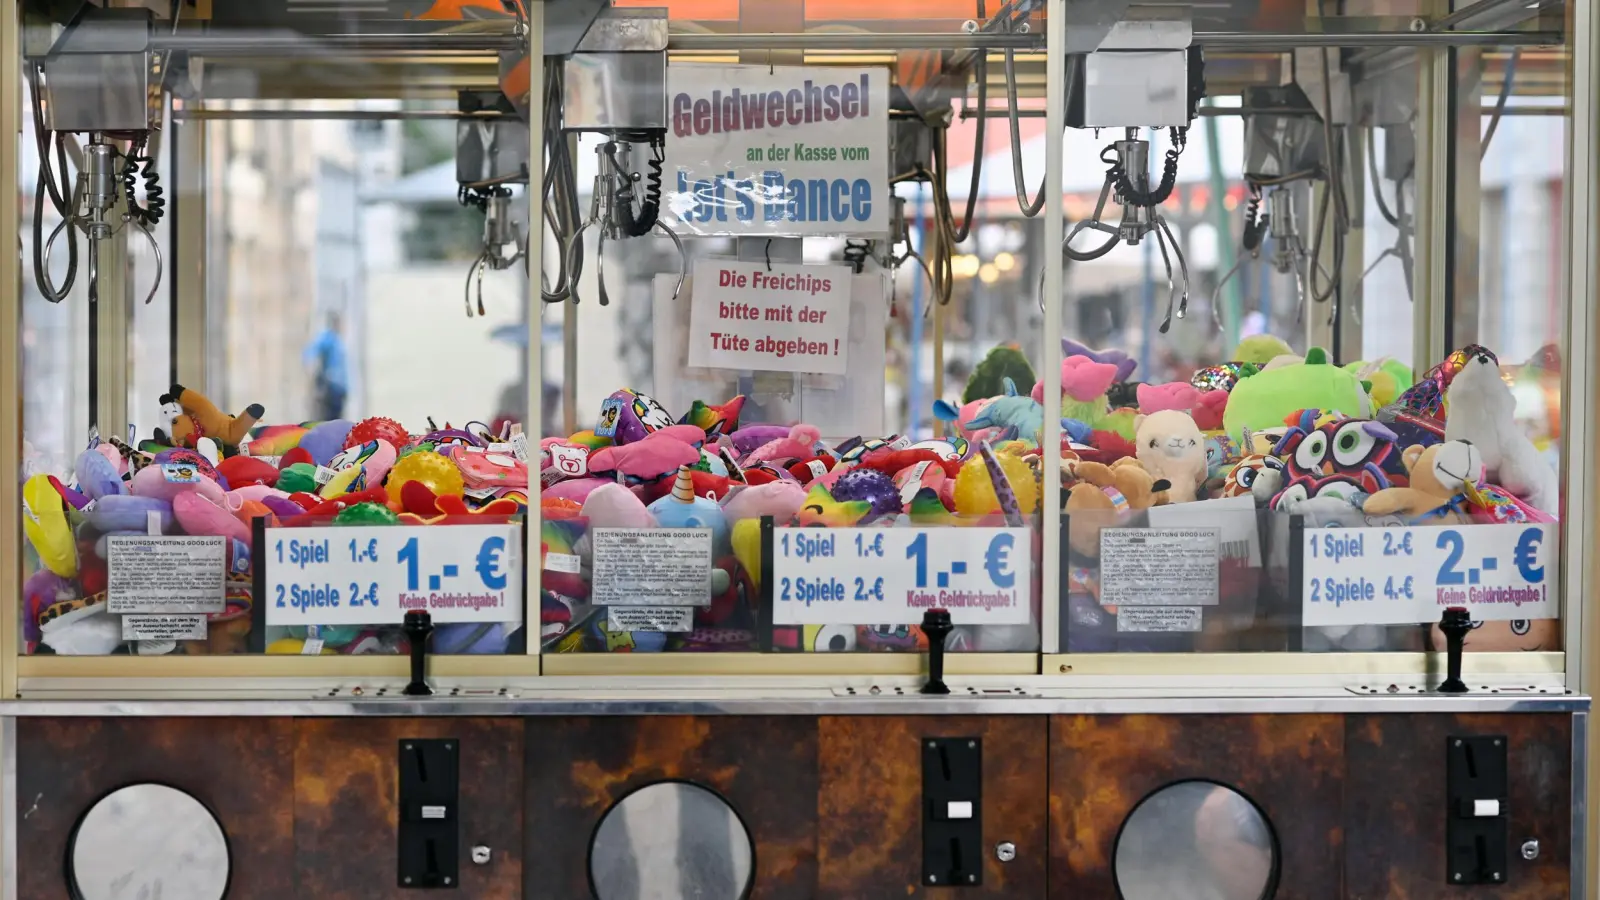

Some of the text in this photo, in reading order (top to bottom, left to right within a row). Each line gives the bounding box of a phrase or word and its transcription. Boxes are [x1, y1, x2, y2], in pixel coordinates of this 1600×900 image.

[673, 73, 869, 138] Geldwechsel
[746, 143, 870, 162] an der Kasse vom
[763, 170, 872, 223] Dance
[719, 269, 832, 296] Die Freichips
[719, 301, 827, 323] bitte mit der
[710, 332, 839, 358] Tüte abgeben !
[275, 537, 378, 569] 1 Spiel 1.-€
[781, 532, 884, 563] 1 Spiel 1.-€
[905, 532, 1016, 589] 1.- €
[1310, 531, 1413, 564] 1 Spiel 2.-€
[1435, 527, 1545, 585] 2.- €
[397, 536, 507, 591] 1.- €
[275, 581, 379, 613] 2 Spiele 2.-€
[399, 591, 504, 612] Keine Geldrückgabe !
[781, 576, 884, 607] 2 Spiele 2.-€
[906, 590, 1017, 612] Keine Geldrückgabe !
[1310, 575, 1414, 608] 2 Spiele 4.-€
[1436, 584, 1546, 607] Keine Geldrückgabe !
